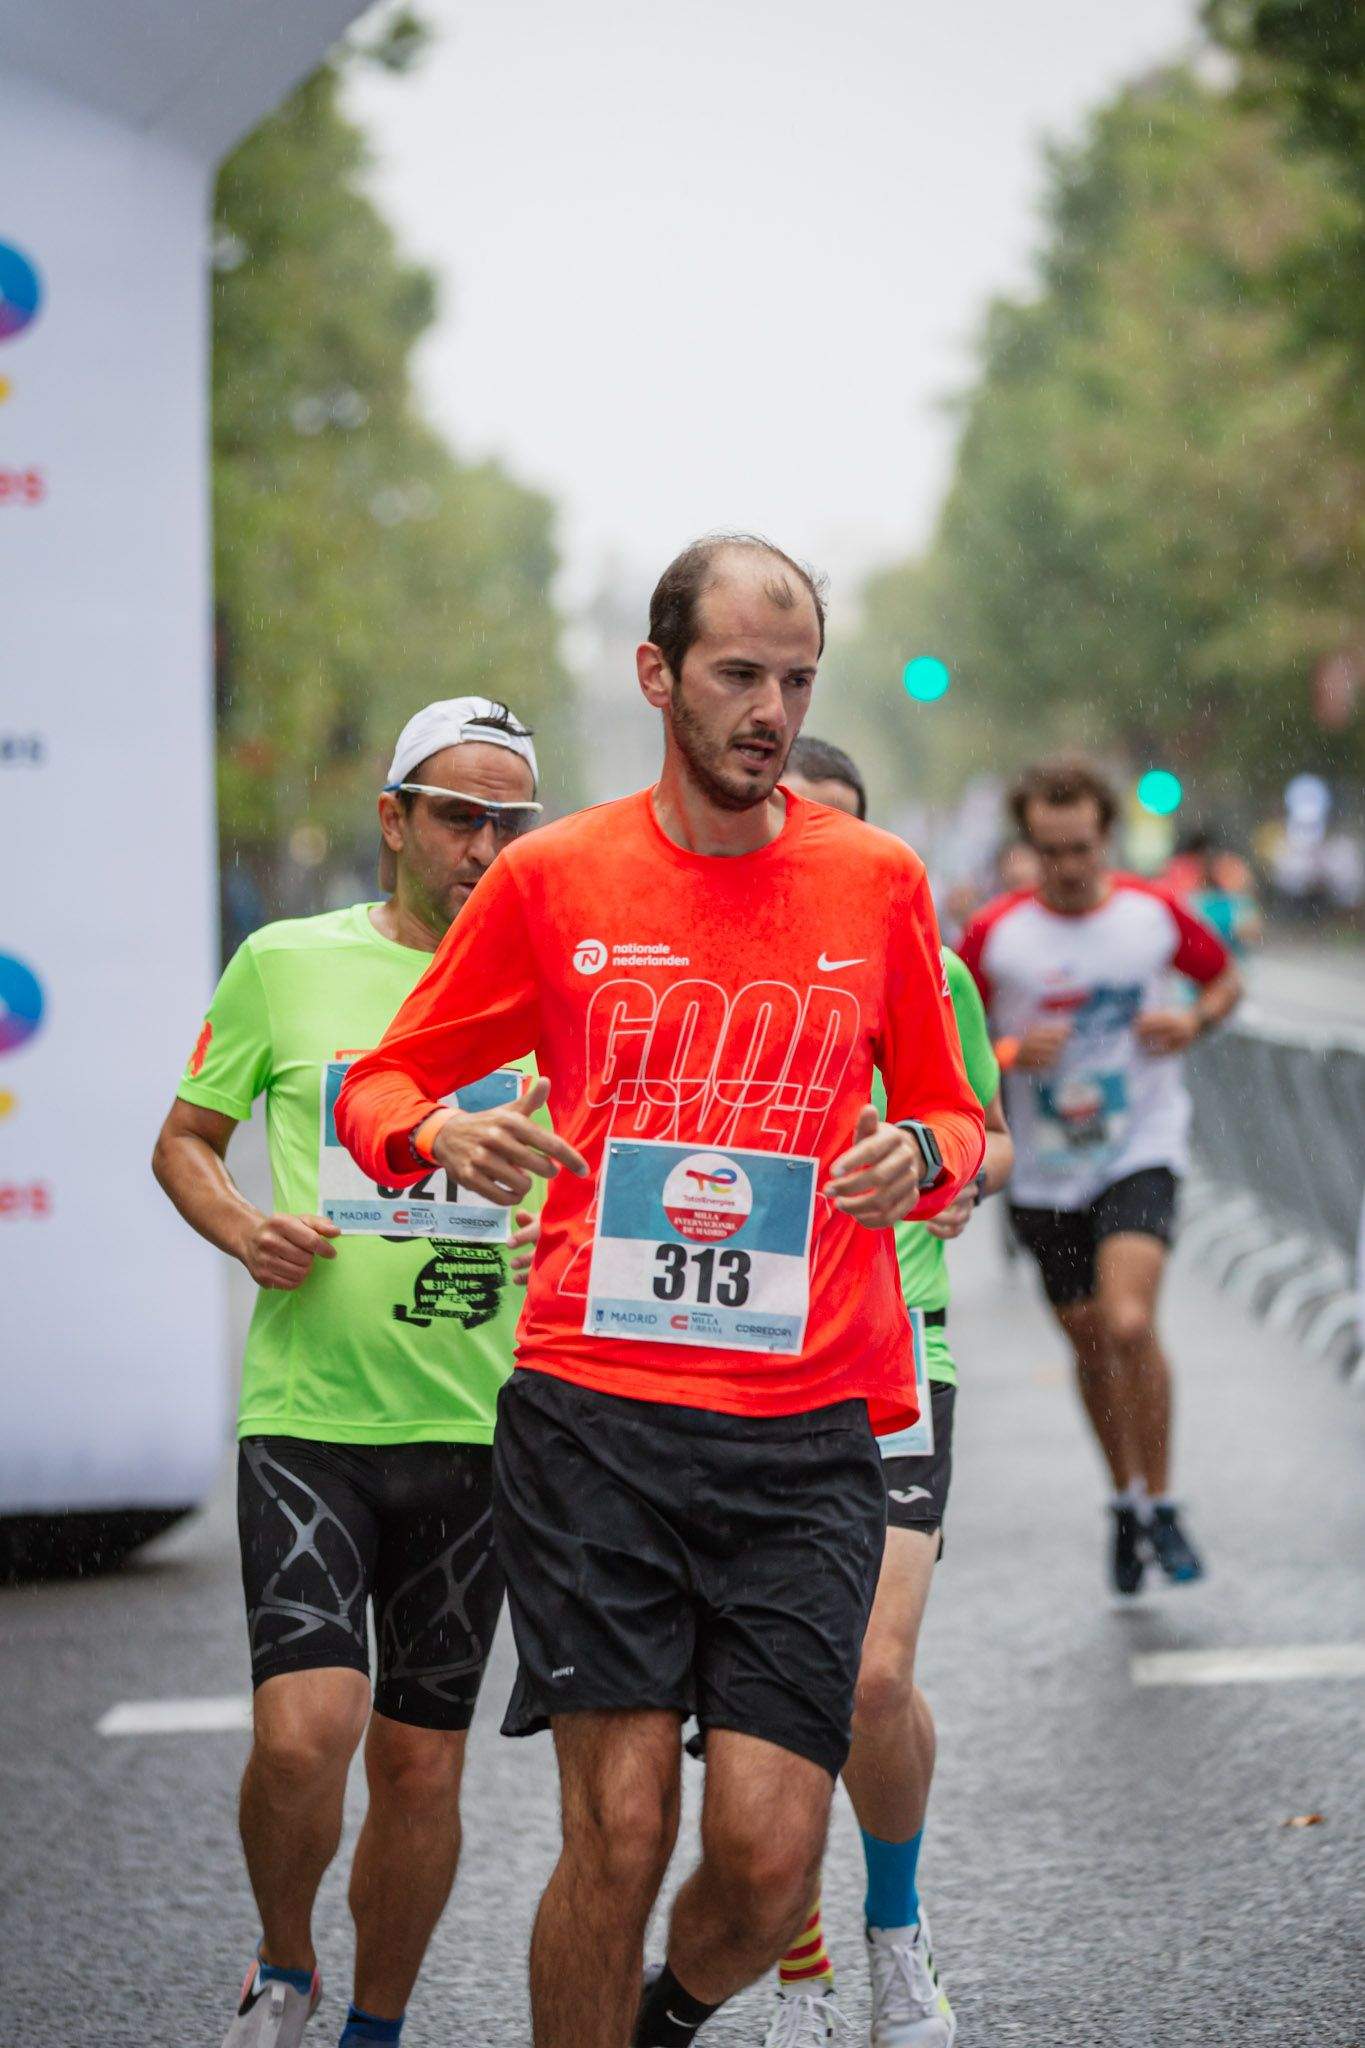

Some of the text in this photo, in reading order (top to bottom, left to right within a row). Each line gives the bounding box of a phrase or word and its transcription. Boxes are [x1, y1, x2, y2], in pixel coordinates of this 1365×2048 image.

[613, 944, 671, 954] nationale
[613, 955, 690, 967] nederlanden
[586, 978, 861, 1113] GOOD
[683, 1194, 736, 1207] TotalEnergies
[340, 1211, 382, 1222] MADRID
[693, 1211, 720, 1221] MILLA
[682, 1226, 728, 1238] DE MADRID
[652, 1243, 752, 1308] 313
[611, 1311, 658, 1326] MADRID
[691, 1314, 720, 1327] MILLA
